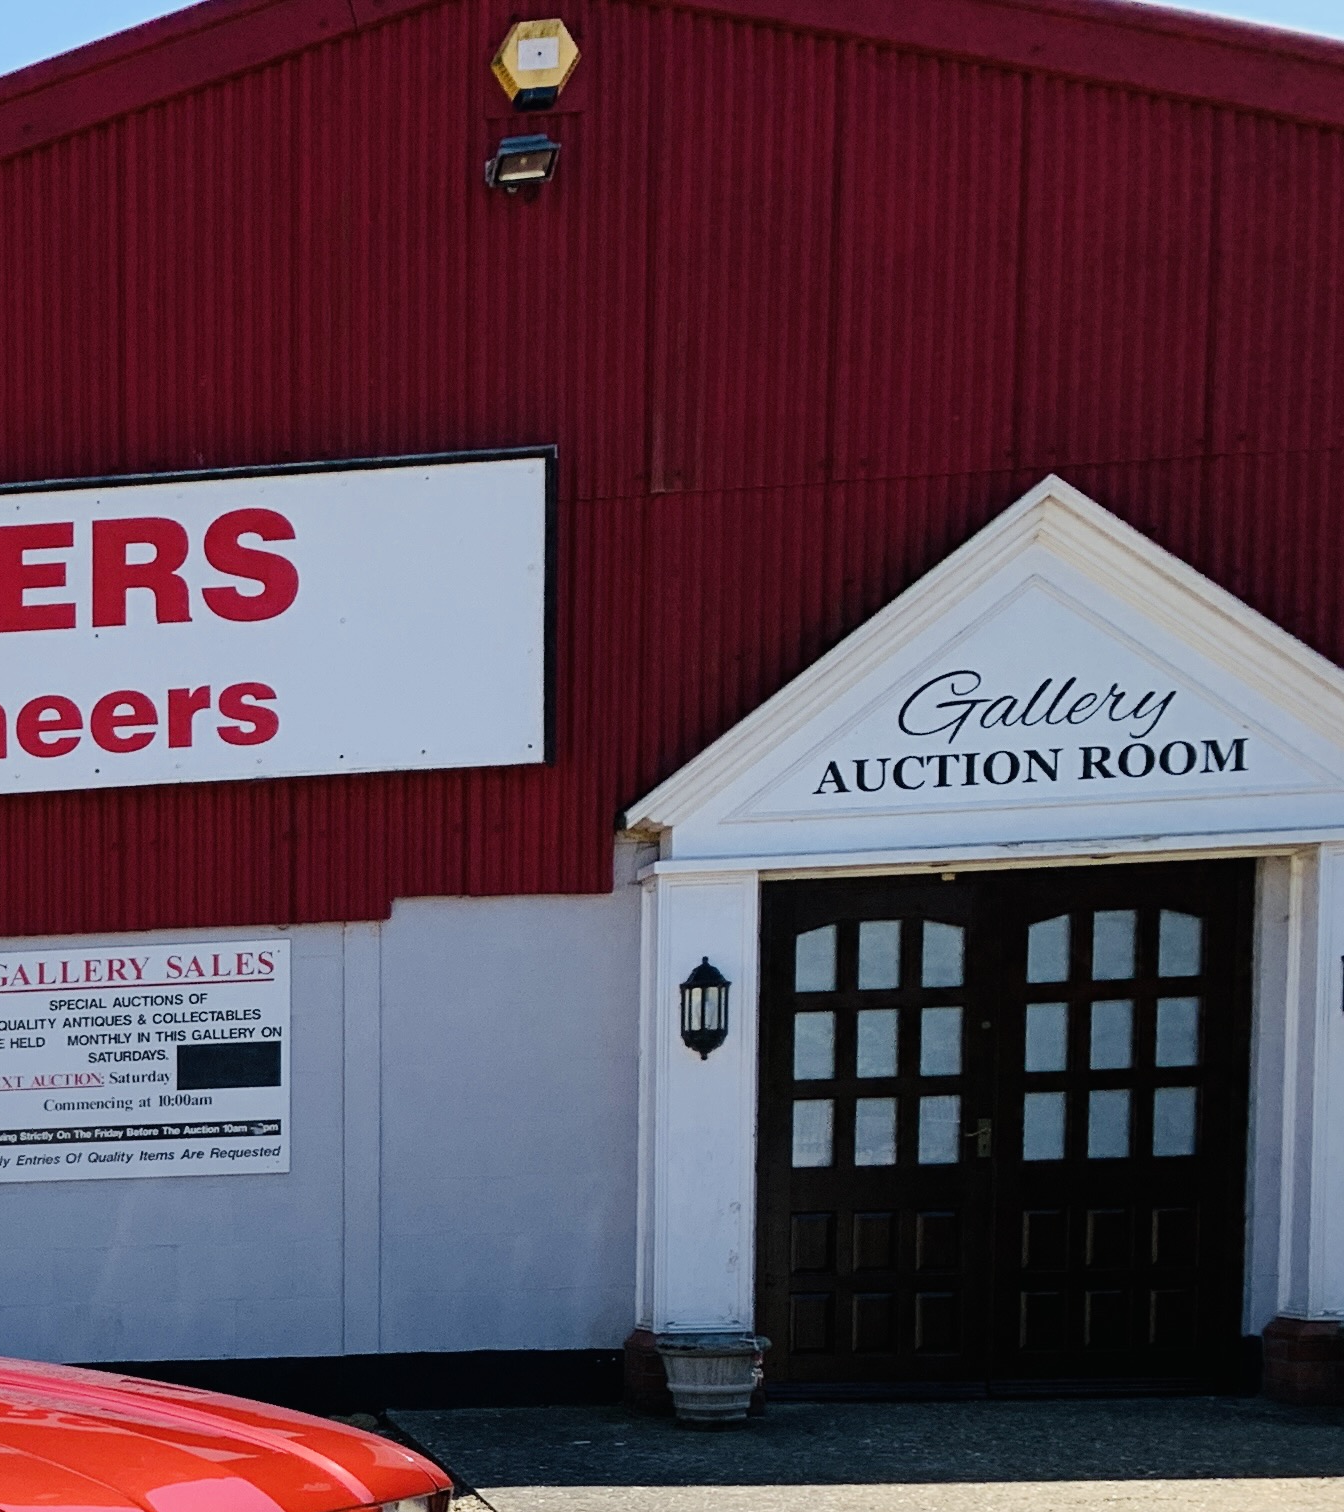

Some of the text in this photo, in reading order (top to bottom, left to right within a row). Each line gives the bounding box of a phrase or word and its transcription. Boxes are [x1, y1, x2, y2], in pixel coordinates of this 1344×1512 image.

[898, 669, 1177, 744] Gallery
[813, 737, 1249, 795] AUCTION ROOM
[165, 950, 275, 980] SALES
[49, 993, 209, 1011] SPECIAL AUCTIONS OF
[62, 1015, 132, 1029] ANTIQUES
[138, 1014, 146, 1026] &
[152, 1009, 262, 1025] COLLECTABLES
[10, 1036, 46, 1049] HELD
[67, 1033, 132, 1047] MONTHLY
[138, 1032, 150, 1043] IN
[155, 1030, 187, 1042] THIS
[191, 1027, 256, 1041] GALLERY
[261, 1026, 282, 1038] ON
[88, 1049, 169, 1064] SATURDAYS.
[31, 1073, 105, 1087] AUCTION:
[109, 1071, 172, 1087] Saturday
[43, 1095, 213, 1112] Commencing at 10:00am
[19, 1130, 54, 1143] Strictly
[56, 1129, 72, 1140] On
[74, 1128, 92, 1139] The
[94, 1127, 123, 1140] Friday
[127, 1126, 159, 1137] Before
[162, 1125, 181, 1135] The
[183, 1123, 220, 1135] Auction
[223, 1123, 248, 1133] 10am
[15, 1153, 61, 1166] Entries
[65, 1151, 82, 1164] Of
[87, 1150, 133, 1165] Quality
[139, 1149, 175, 1161] Items
[181, 1147, 205, 1159] Are
[209, 1145, 281, 1161] Requested
